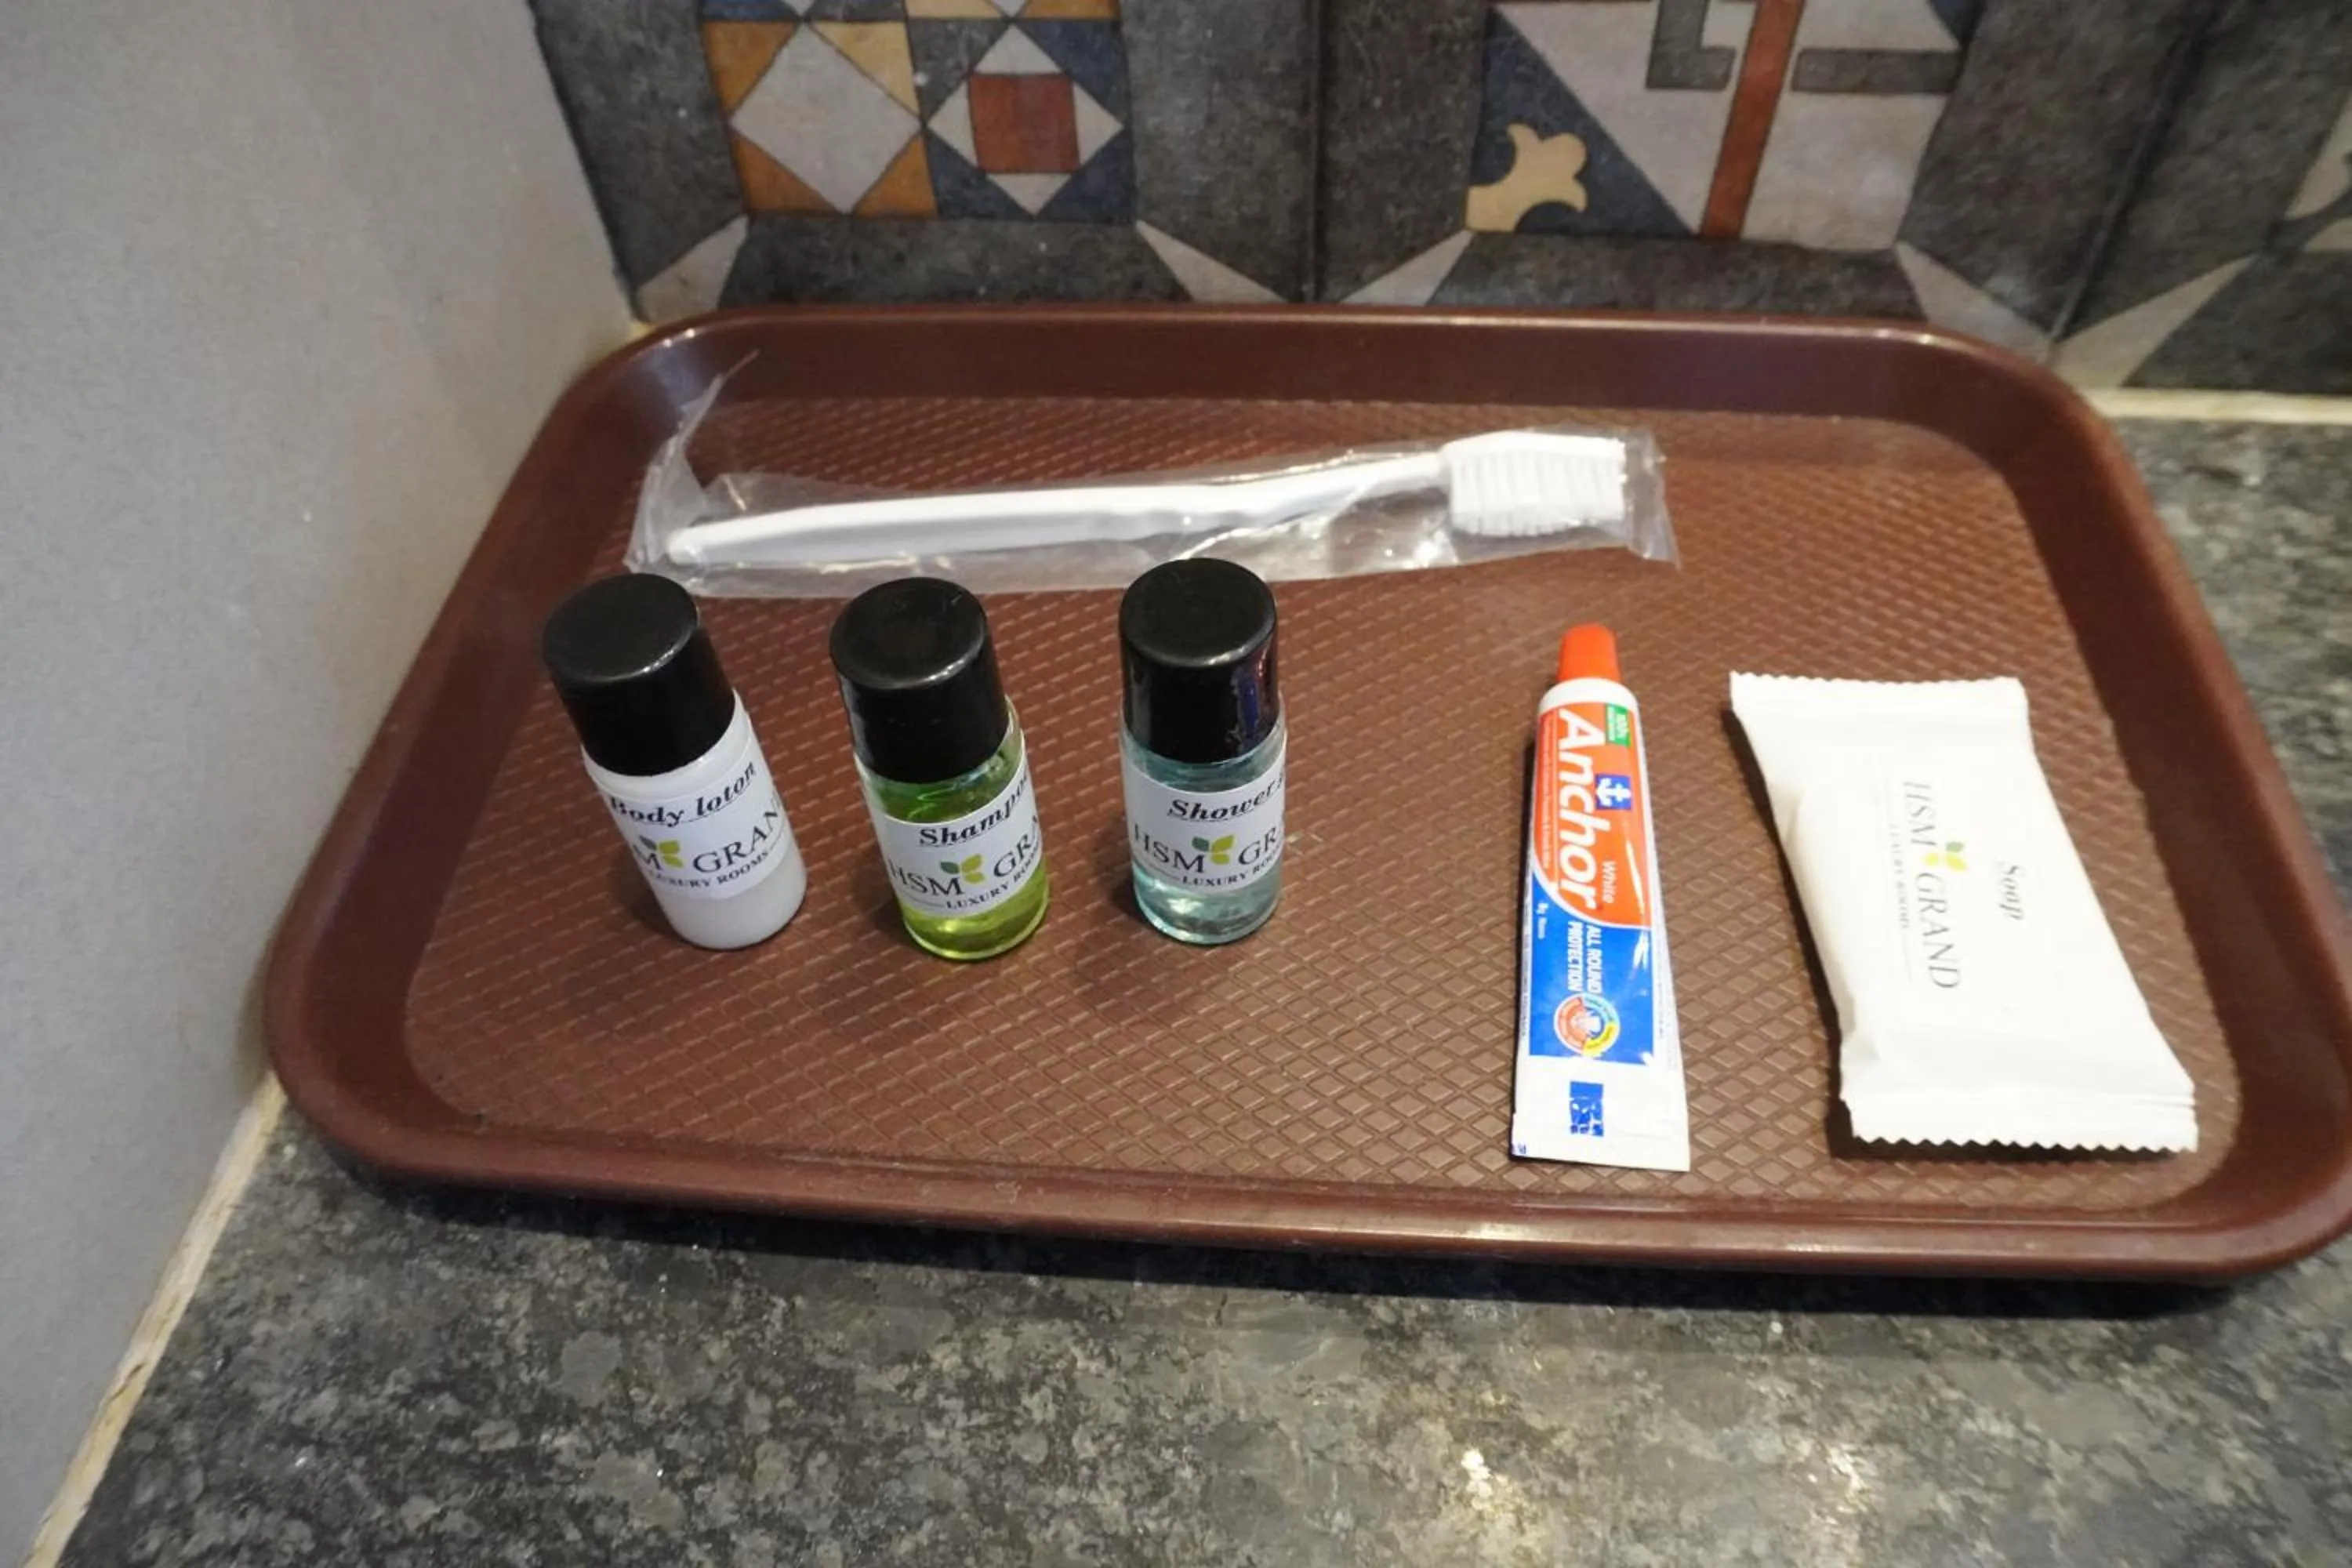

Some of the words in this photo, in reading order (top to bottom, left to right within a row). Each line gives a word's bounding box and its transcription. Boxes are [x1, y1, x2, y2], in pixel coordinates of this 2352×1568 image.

[1557, 707, 1611, 911] Anchor
[1134, 822, 1205, 874] HSM
[946, 880, 1010, 909] LUXURY
[1602, 860, 1617, 905] White
[1997, 860, 2027, 921] Soap
[1586, 924, 1602, 946] ALL
[1914, 871, 1962, 989] GRAND
[1567, 920, 1584, 993] PROTECTION
[1587, 948, 1602, 993] ROUND
